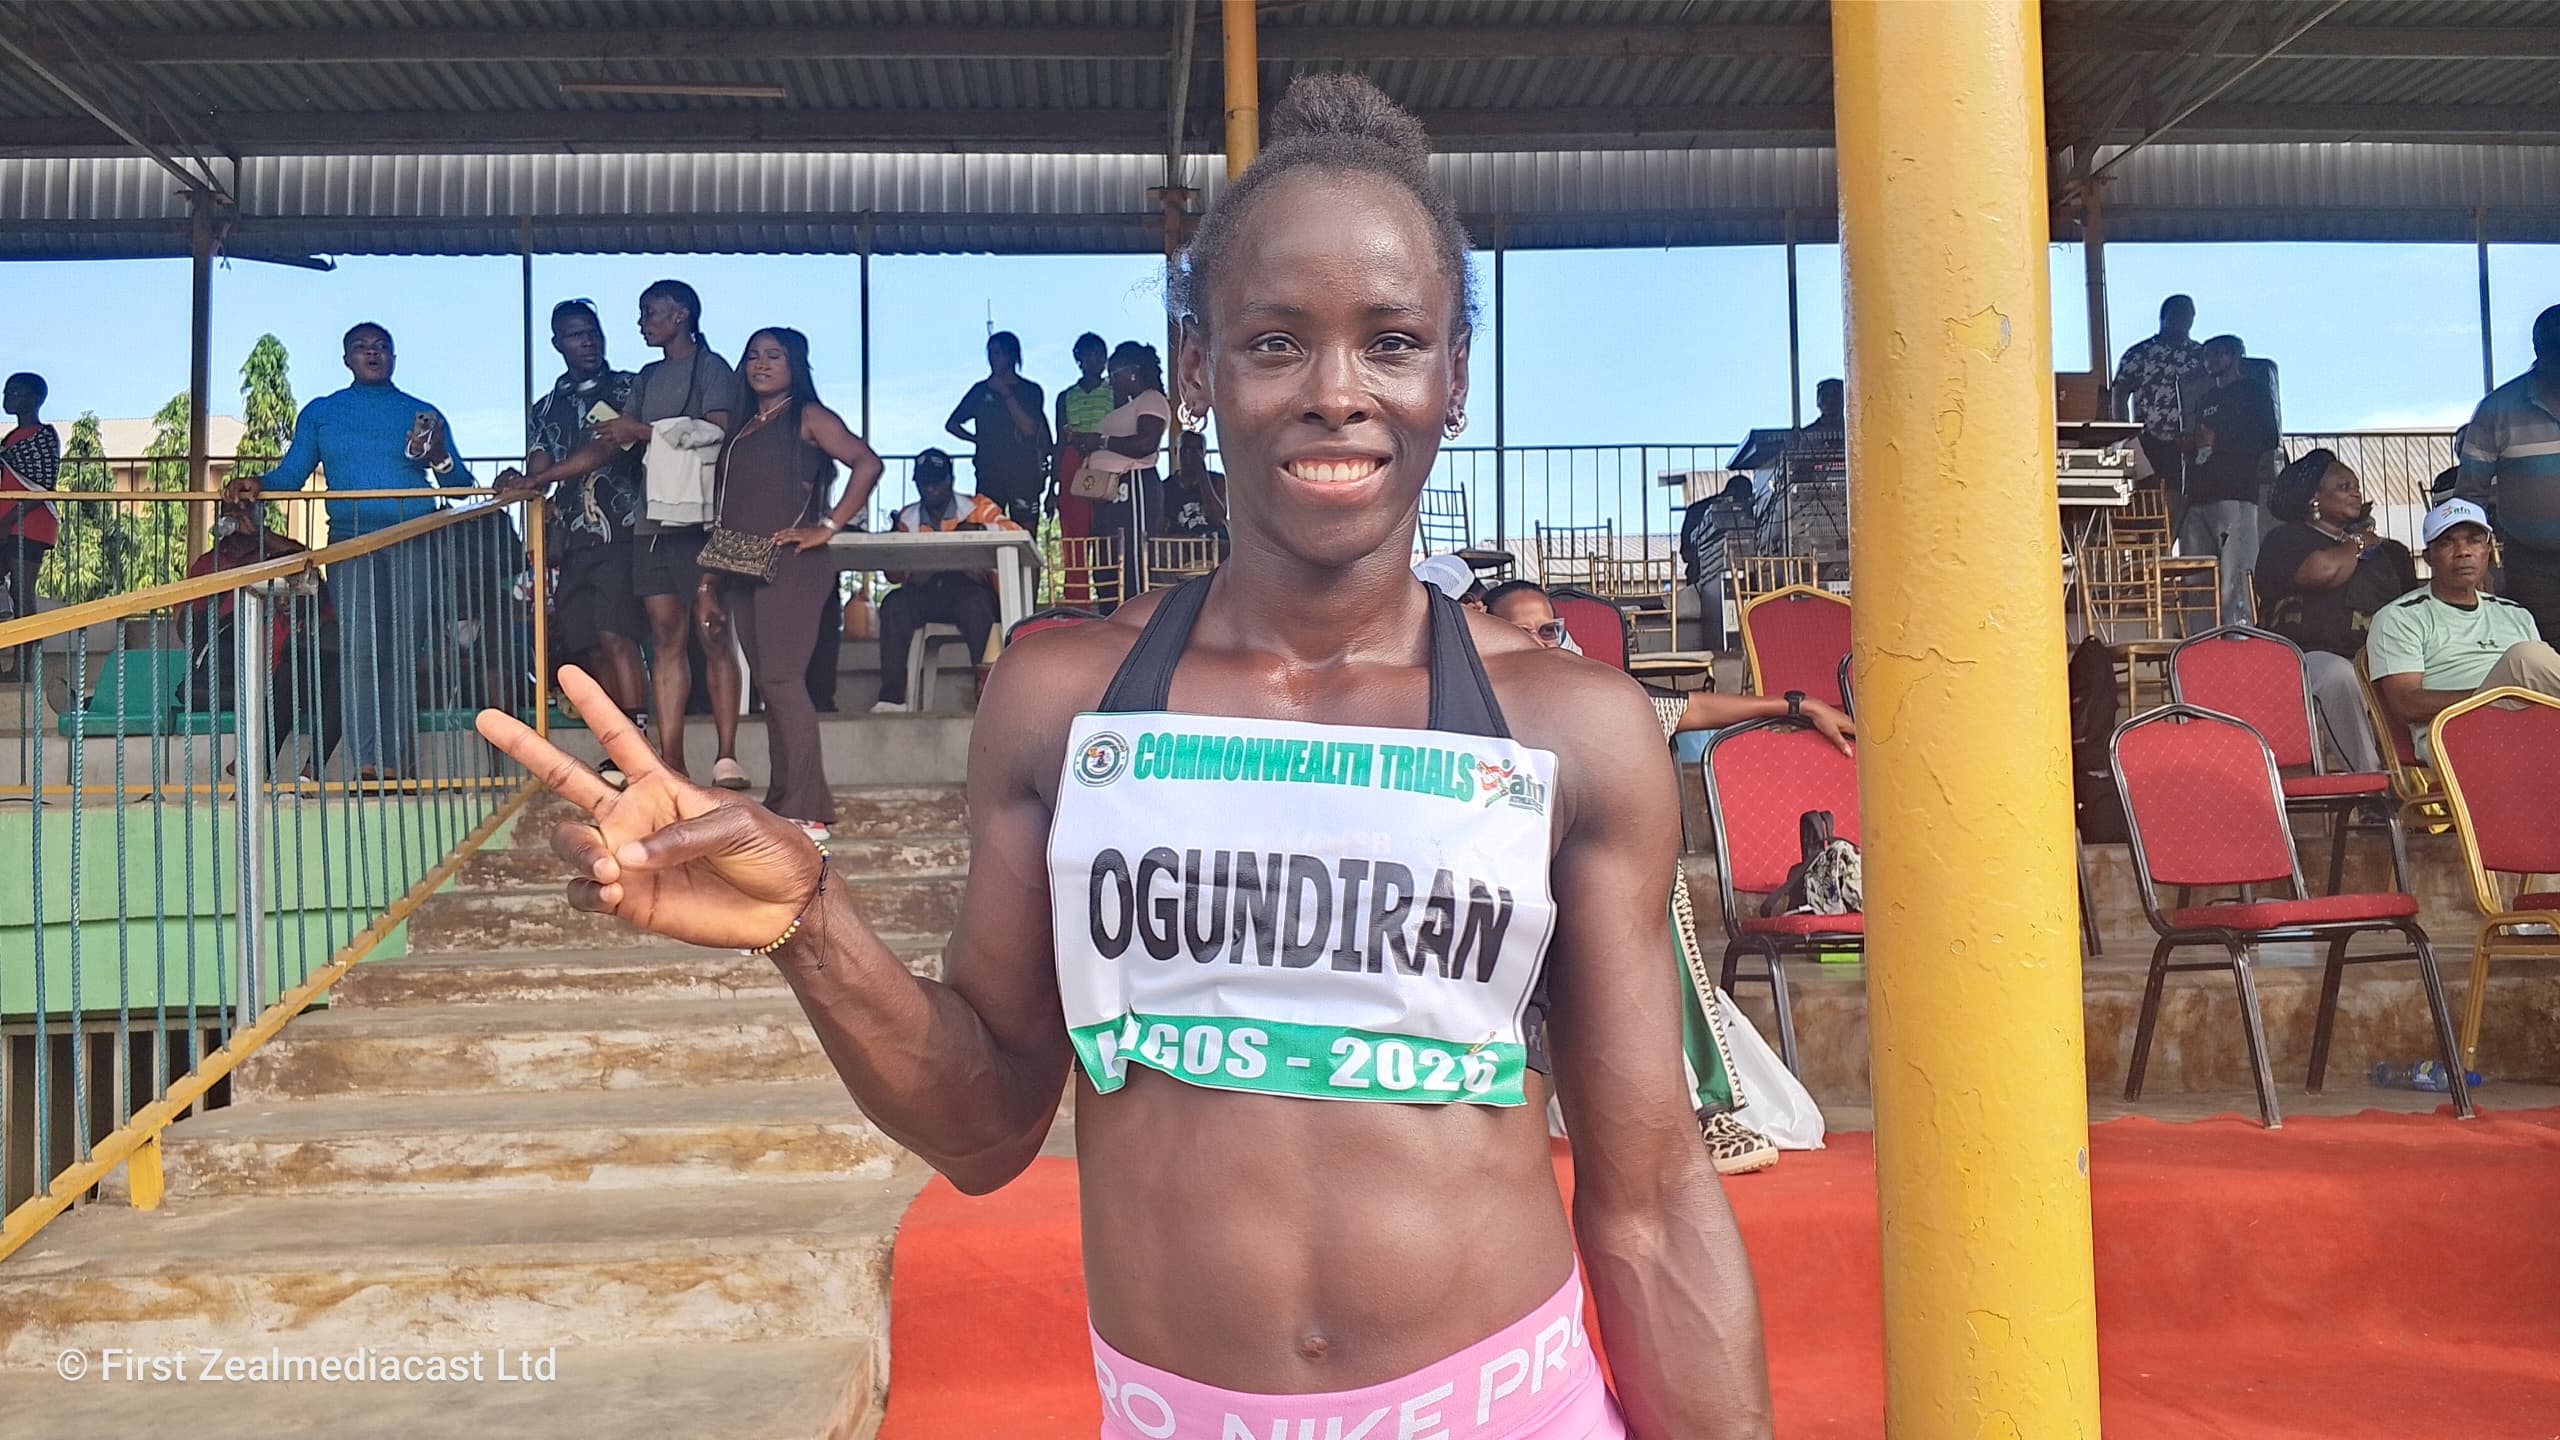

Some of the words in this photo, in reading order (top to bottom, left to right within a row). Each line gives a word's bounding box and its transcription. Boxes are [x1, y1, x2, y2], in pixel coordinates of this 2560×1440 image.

[1134, 732, 1373, 789] COMMONWEALTH
[1380, 746, 1476, 803] TRIALS
[1088, 846, 1515, 984] OGUNDIRAN
[1286, 1057, 1310, 1067] -
[1329, 1037, 1499, 1093] 2026
